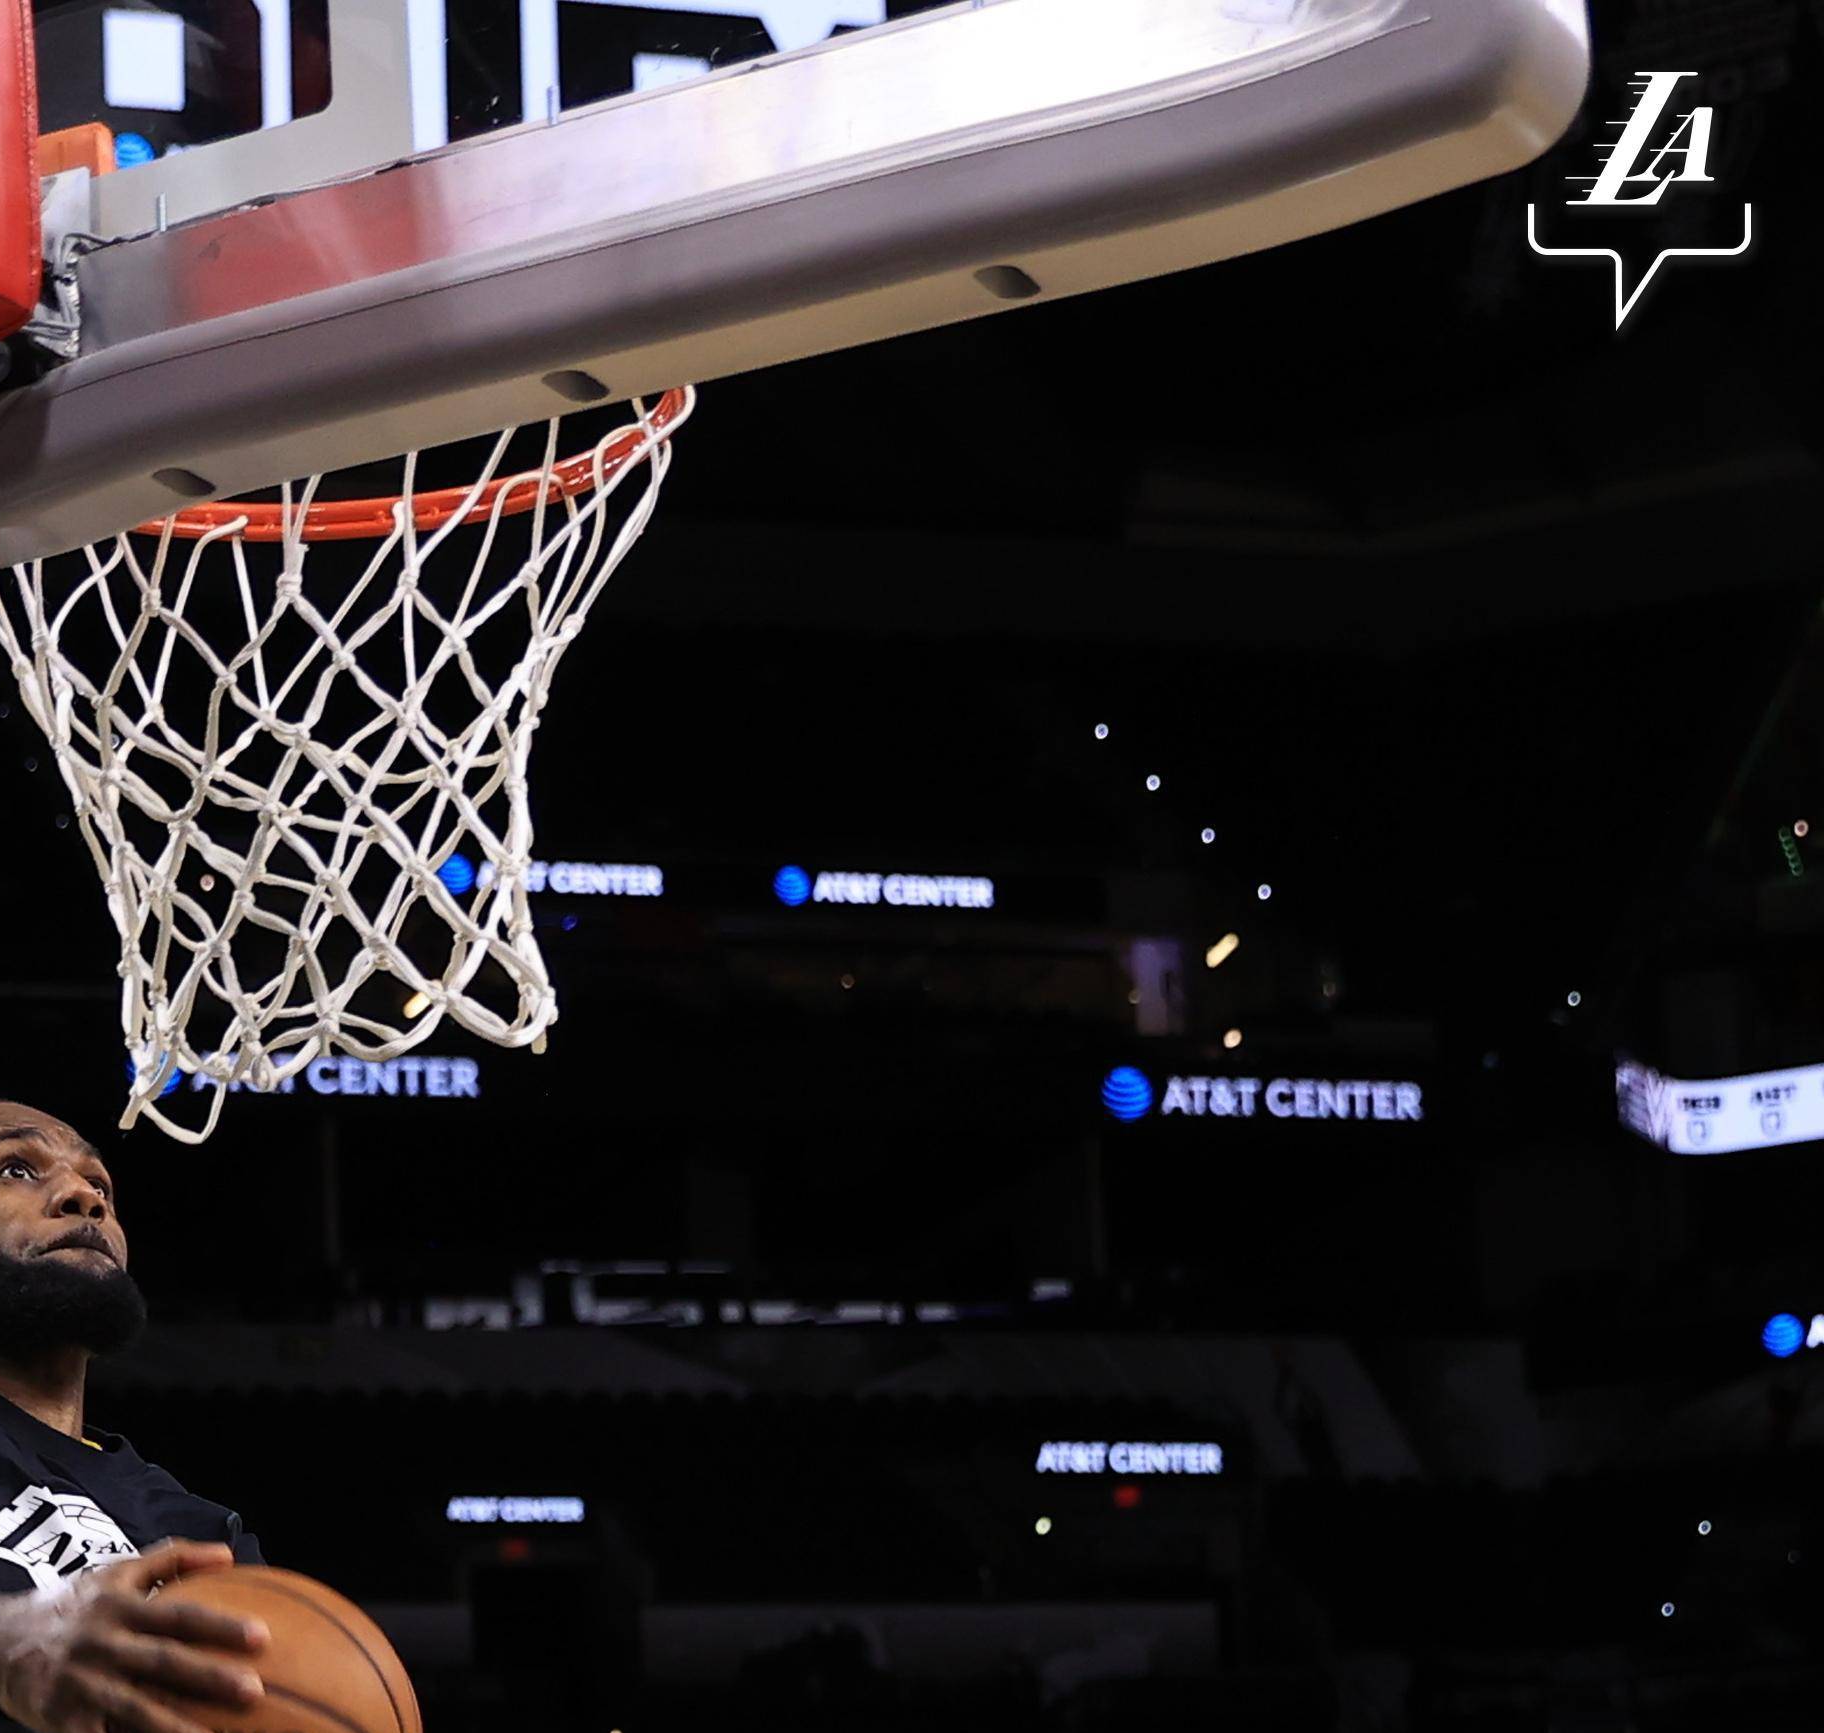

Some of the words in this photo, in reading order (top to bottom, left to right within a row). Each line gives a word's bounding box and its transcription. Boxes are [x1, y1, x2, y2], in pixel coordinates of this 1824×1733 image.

[549, 861, 664, 897] CENTER
[883, 872, 994, 909] CENTER
[307, 1055, 479, 1098] CENTER
[1161, 1075, 1261, 1116] AT&T
[1264, 1078, 1423, 1121] CENTER
[1108, 1441, 1223, 1474] CENTER
